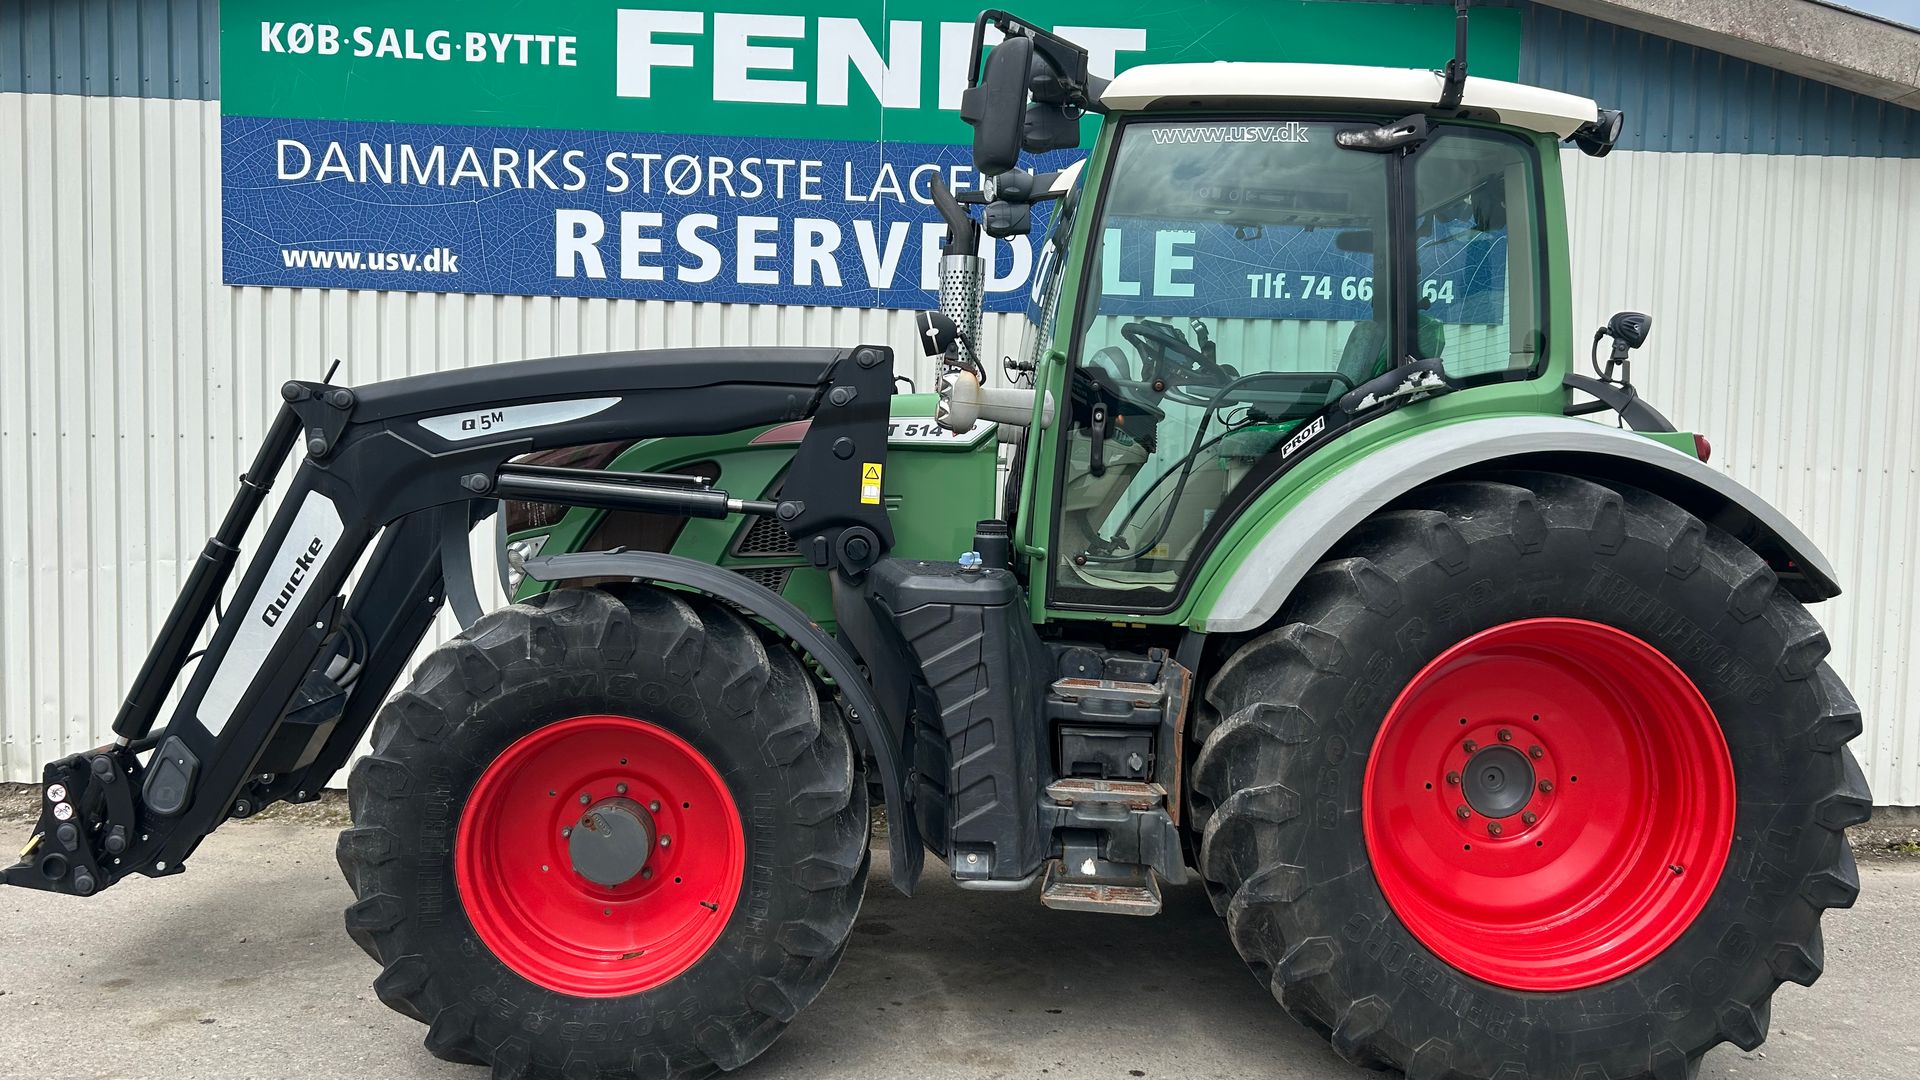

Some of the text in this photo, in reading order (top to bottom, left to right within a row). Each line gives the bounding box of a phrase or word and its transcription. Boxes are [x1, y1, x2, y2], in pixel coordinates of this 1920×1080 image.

[1151, 121, 1309, 144] www.usv.dk
[276, 139, 587, 192] DANMARKS
[605, 151, 822, 202] STØRSTE
[844, 161, 990, 206] LAGE
[281, 248, 459, 274] www.usv.dk
[1246, 272, 1455, 304] Tlf. 74 66 64
[904, 423, 943, 437] 514
[1282, 417, 1325, 456] PROFI
[262, 536, 323, 628] Quicke
[1583, 561, 1775, 705] TRELLEBORG
